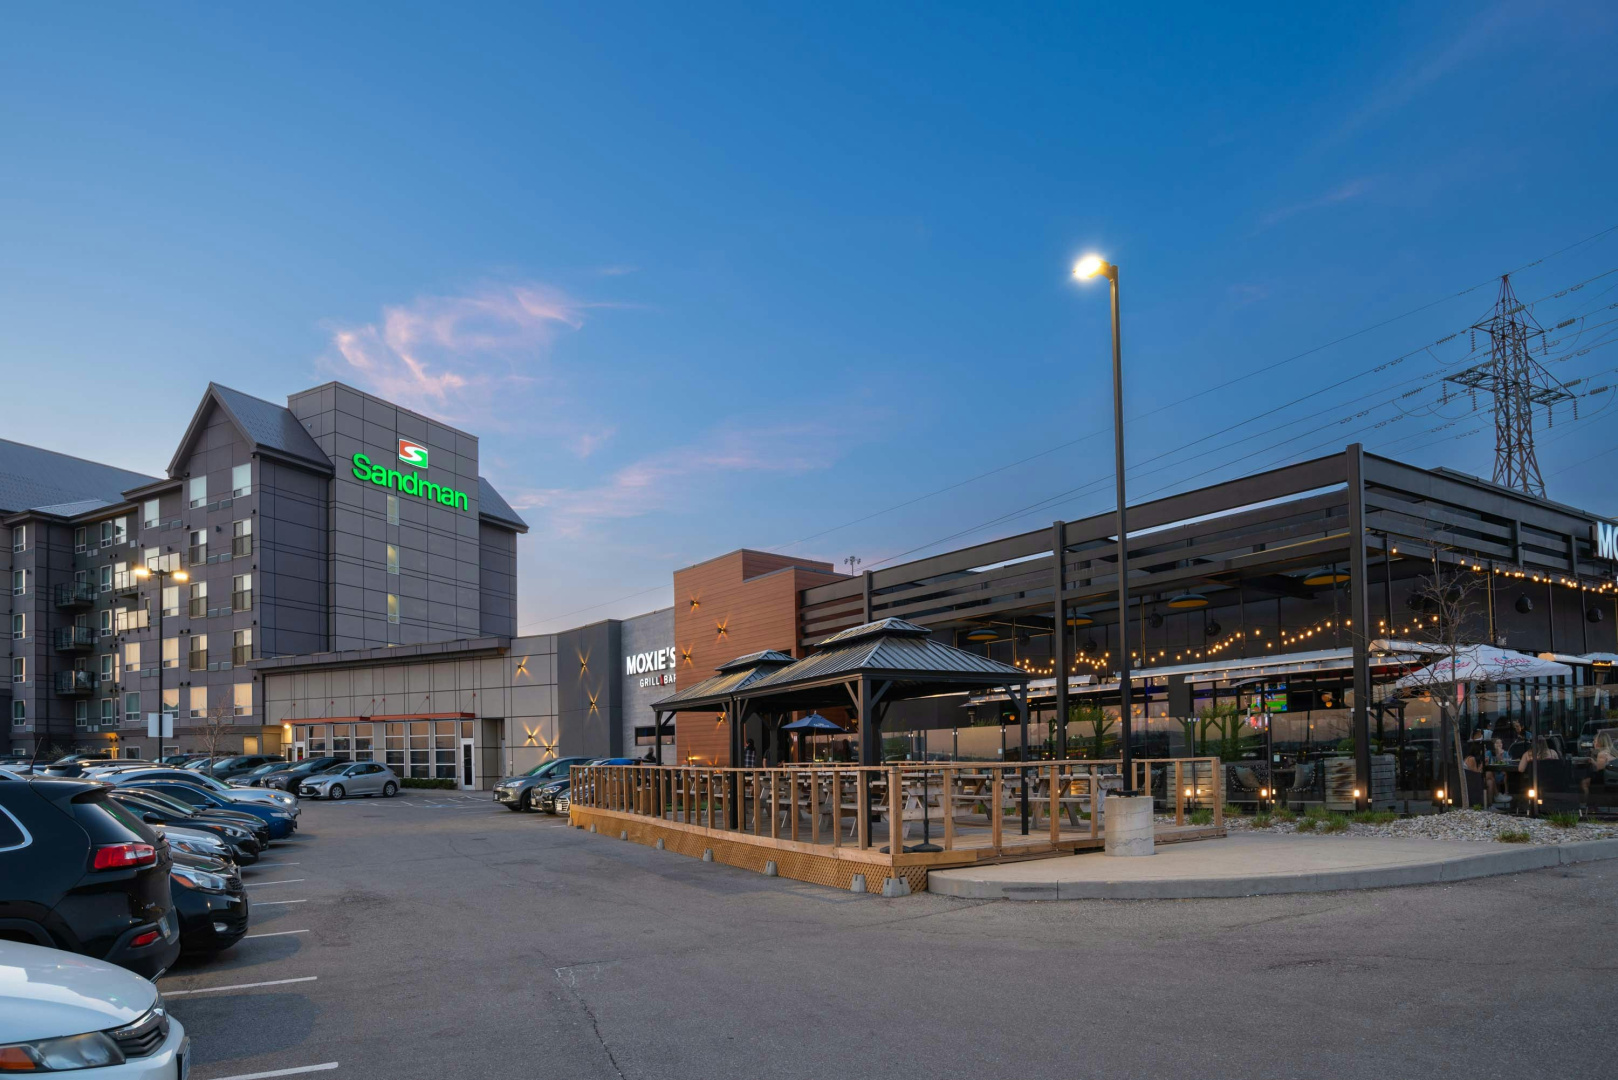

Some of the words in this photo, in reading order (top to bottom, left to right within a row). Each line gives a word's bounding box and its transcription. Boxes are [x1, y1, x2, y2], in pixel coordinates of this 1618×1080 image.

[352, 453, 468, 511] Sandman
[626, 646, 676, 675] MOXIE'S
[640, 676, 660, 688] GRILL
